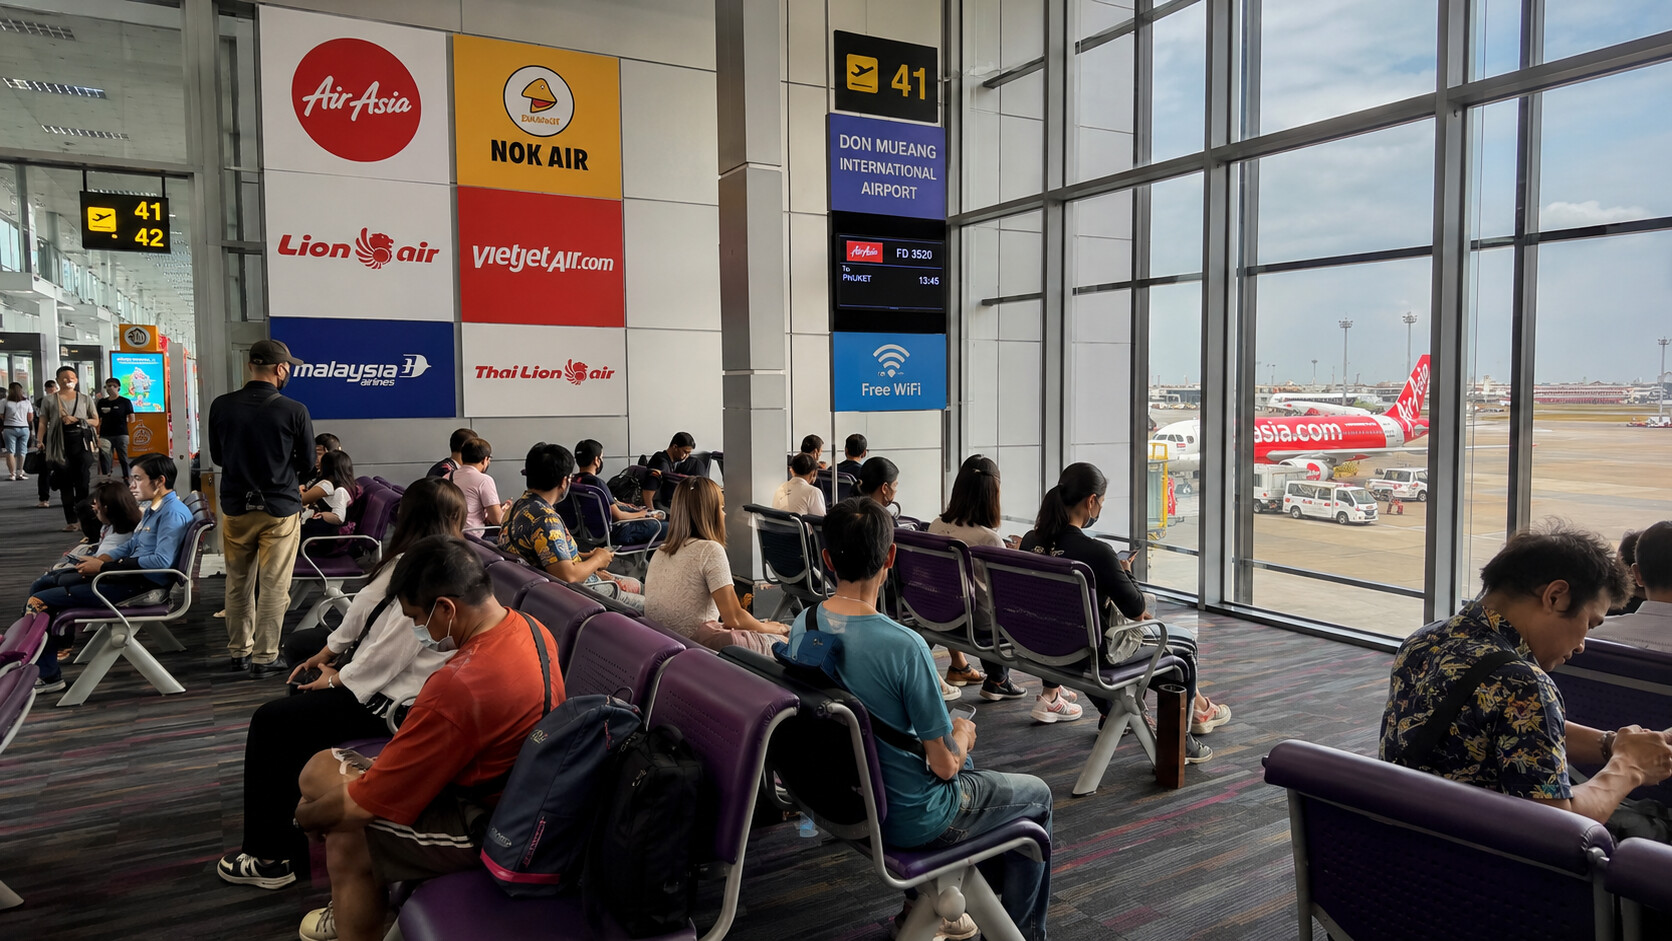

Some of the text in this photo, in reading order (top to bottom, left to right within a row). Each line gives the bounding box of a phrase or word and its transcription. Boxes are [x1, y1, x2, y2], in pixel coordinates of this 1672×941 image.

[891, 64, 926, 100] 41
[491, 139, 588, 171] NOK AIR
[839, 134, 936, 159] DON MUEANG
[840, 157, 937, 180] INTERNATIONAL
[861, 182, 917, 200] AIRPORT
[134, 201, 161, 221] 41
[134, 227, 164, 247] 42
[278, 234, 440, 263] Lion air
[896, 248, 909, 259] FD
[911, 249, 933, 260] 3520
[918, 276, 940, 285] 13:45
[293, 360, 398, 383] malaysia
[475, 365, 615, 380] Thai Lion air
[861, 383, 921, 396] Free WiFi
